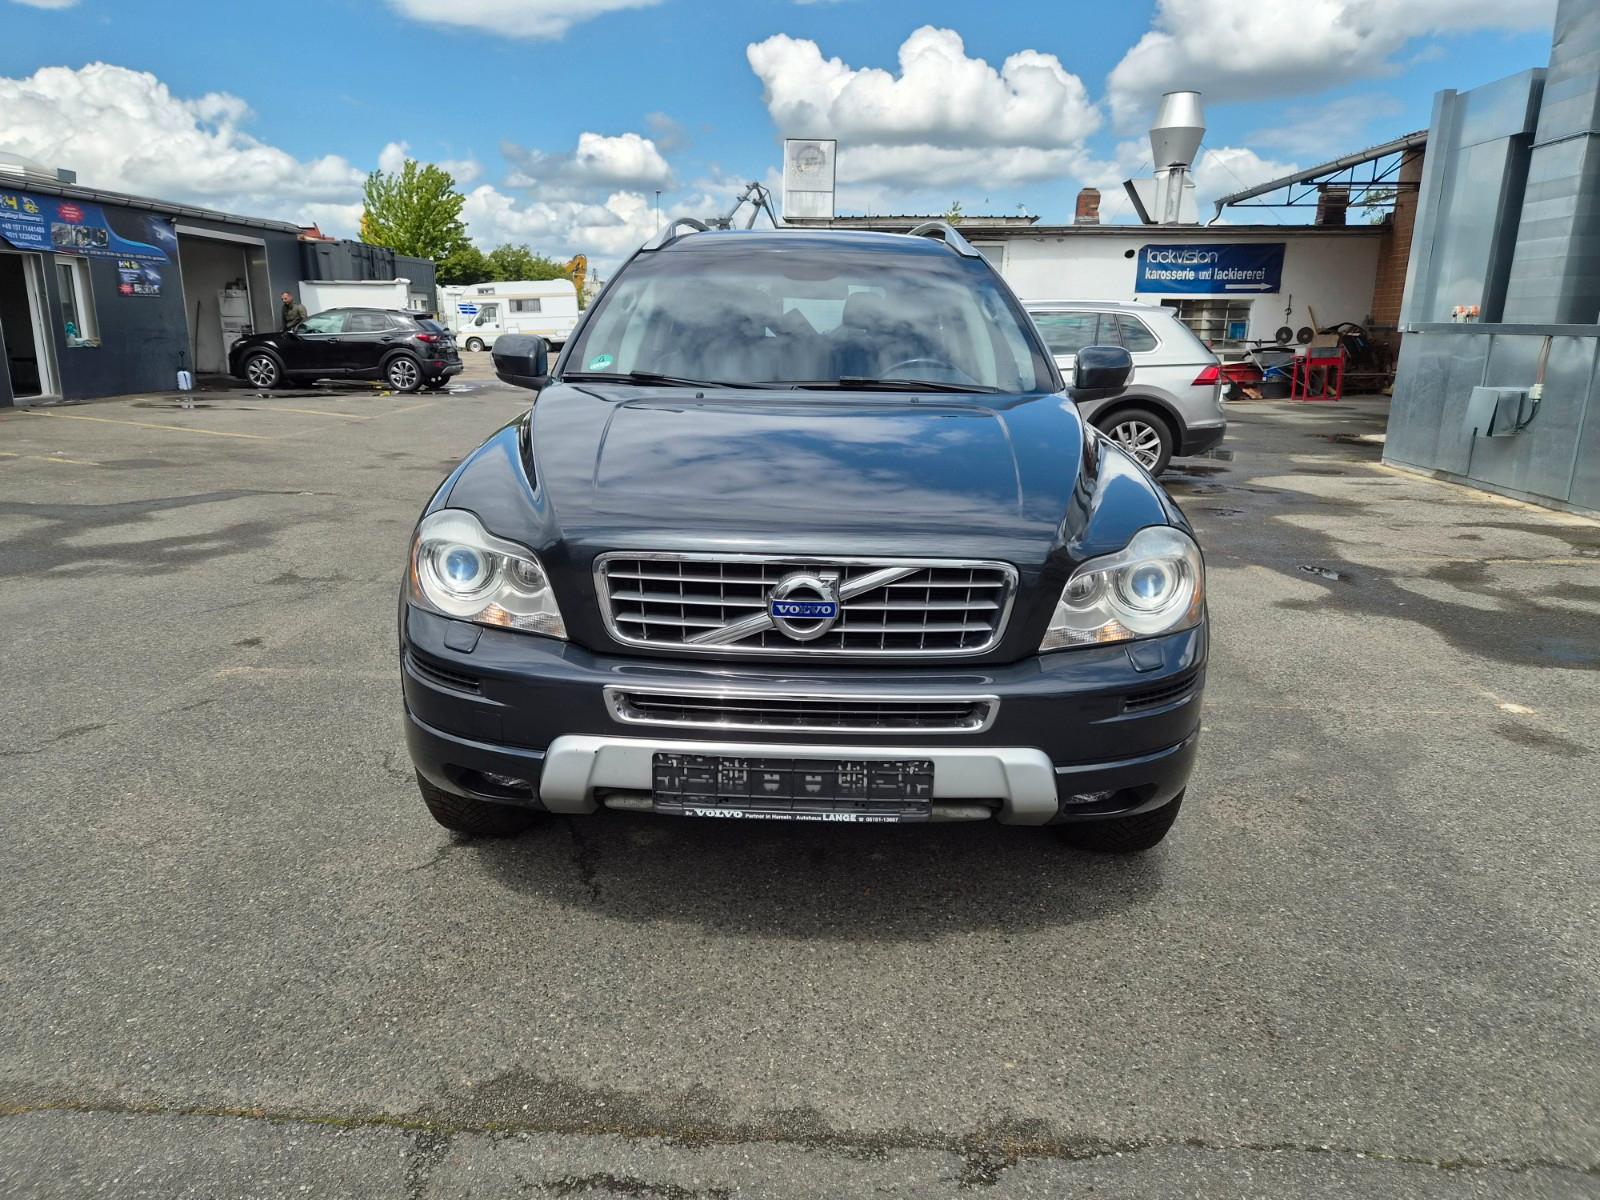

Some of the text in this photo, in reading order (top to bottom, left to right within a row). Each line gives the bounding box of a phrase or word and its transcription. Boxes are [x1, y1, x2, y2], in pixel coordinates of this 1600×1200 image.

[1146, 249, 1218, 264] lackvision
[1145, 267, 1265, 281] karosserie und lackiererei
[776, 604, 832, 614] VOLVO
[694, 808, 743, 818] VOLVO
[822, 812, 857, 822] LANGE
